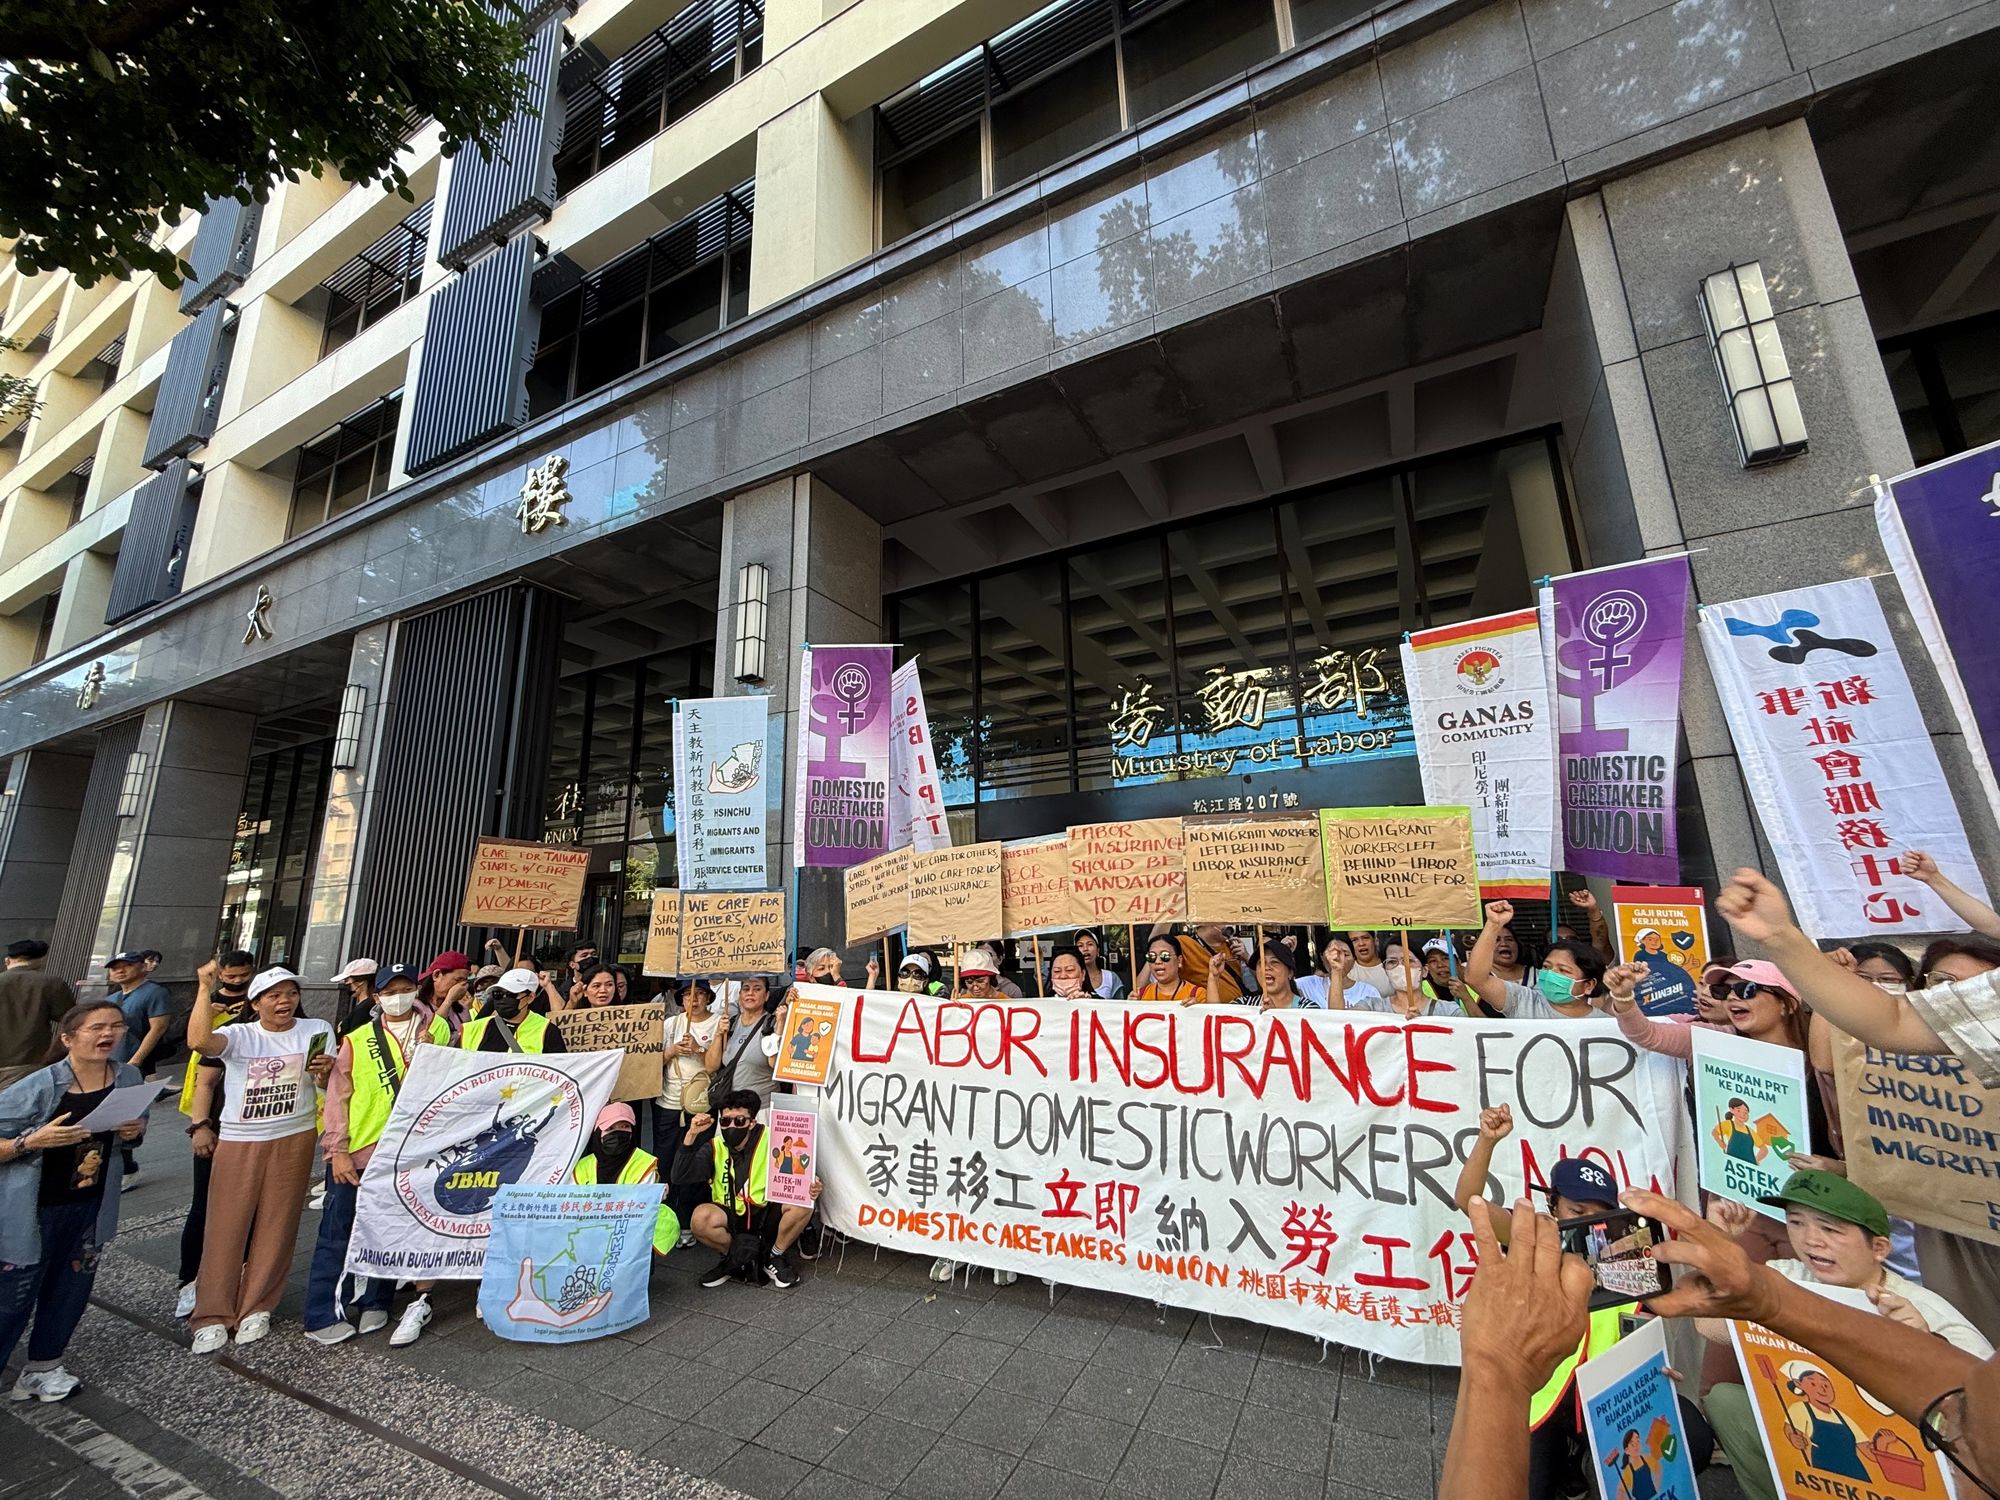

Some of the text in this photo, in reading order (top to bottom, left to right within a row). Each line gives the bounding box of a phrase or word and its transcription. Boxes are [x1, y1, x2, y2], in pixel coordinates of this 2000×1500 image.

[1438, 700, 1534, 730] GANAS
[1442, 723, 1534, 744] COMMUNITY
[1111, 728, 1396, 780] Ministry of Labor
[1567, 755, 1665, 782] DOMESTIC
[1472, 751, 1490, 808] 印尼勞工
[812, 779, 885, 799] DOMESTIC
[1568, 784, 1663, 808] CARETAKER
[714, 807, 750, 817] HSINCHU
[811, 799, 884, 817] CARETAKER
[1193, 793, 1299, 813] 松江路207號
[743, 827, 760, 835] AND
[809, 818, 883, 848] UNION
[1071, 825, 1133, 841] LABOR
[1190, 832, 1209, 842] NO
[1268, 829, 1319, 838] WORKERS
[1338, 824, 1437, 839] NO MIGRANT
[1568, 809, 1665, 855] UNION
[520, 851, 541, 860] FOR
[1200, 843, 1285, 857] LEFT BEHIND
[1340, 841, 1439, 855] WORKERS LEFT
[536, 865, 572, 876] CARE
[706, 865, 764, 875] SERVICE CENTER
[913, 860, 927, 869] WE
[929, 855, 949, 866] CARE
[1072, 855, 1175, 874] SHOULD BE
[1193, 856, 1311, 871] LABOR INSURANCE
[1343, 857, 1457, 872] BEHIND LABOR
[915, 866, 985, 885] WHO CARE FOR
[1074, 871, 1186, 892] MANDATORY
[1225, 871, 1250, 880] FOR
[1345, 872, 1466, 886] INSURANCE FOR
[498, 876, 557, 894] DOMESTIC
[911, 880, 992, 899] LABOR INSURANCE
[1383, 887, 1416, 899] ALL
[688, 900, 708, 911] WE
[718, 898, 750, 910] CARE
[760, 898, 780, 907] FOR
[1089, 896, 1116, 915] TO
[1634, 909, 1686, 918] GAJI RUTIN,
[748, 913, 778, 925] WHO
[1632, 918, 1660, 926] KERJA
[687, 932, 715, 944] CARE
[686, 947, 725, 959] LABOR
[556, 1008, 664, 1026] WE CARE FOR
[615, 1021, 650, 1032] WHO
[593, 1032, 647, 1045] FOR US?
[851, 995, 1647, 1135] LABOR INSURANCE FOR
[1865, 1045, 1969, 1085] LABOR
[1705, 1064, 1788, 1095] MASUKAN PRT
[246, 1083, 297, 1097] DOMESTIC
[246, 1092, 295, 1104] CARETAKER
[1719, 1079, 1776, 1103] KE DALAM
[1859, 1073, 1983, 1117] SHOULD
[242, 1101, 295, 1119] UNION
[415, 1066, 560, 1136] JARINGAN BURUH MIGRAN
[823, 1070, 992, 1141] MIGRANT
[994, 1088, 1224, 1183] DOMESTIC
[445, 1171, 500, 1189] JBMI
[773, 1175, 802, 1186] ASTEK-IN
[1724, 1160, 1780, 1192] ASTEK
[784, 1185, 796, 1193] PRT
[399, 1169, 448, 1231] INDONESIAN
[857, 1204, 978, 1243] DOMESTIC
[982, 1221, 1128, 1265] CARETAKERS
[1137, 1251, 1229, 1288] UNION
[355, 1248, 484, 1269] JARINGAN BURUH MIGRAN
[1744, 1332, 1785, 1350] BUKAN
[1595, 1401, 1612, 1418] PRT
[1614, 1385, 1634, 1407] JUGA
[1605, 1399, 1633, 1426] BUKAN
[1616, 1401, 1653, 1432] KERJAAN.
[1794, 1471, 1862, 1500] ASTEK
